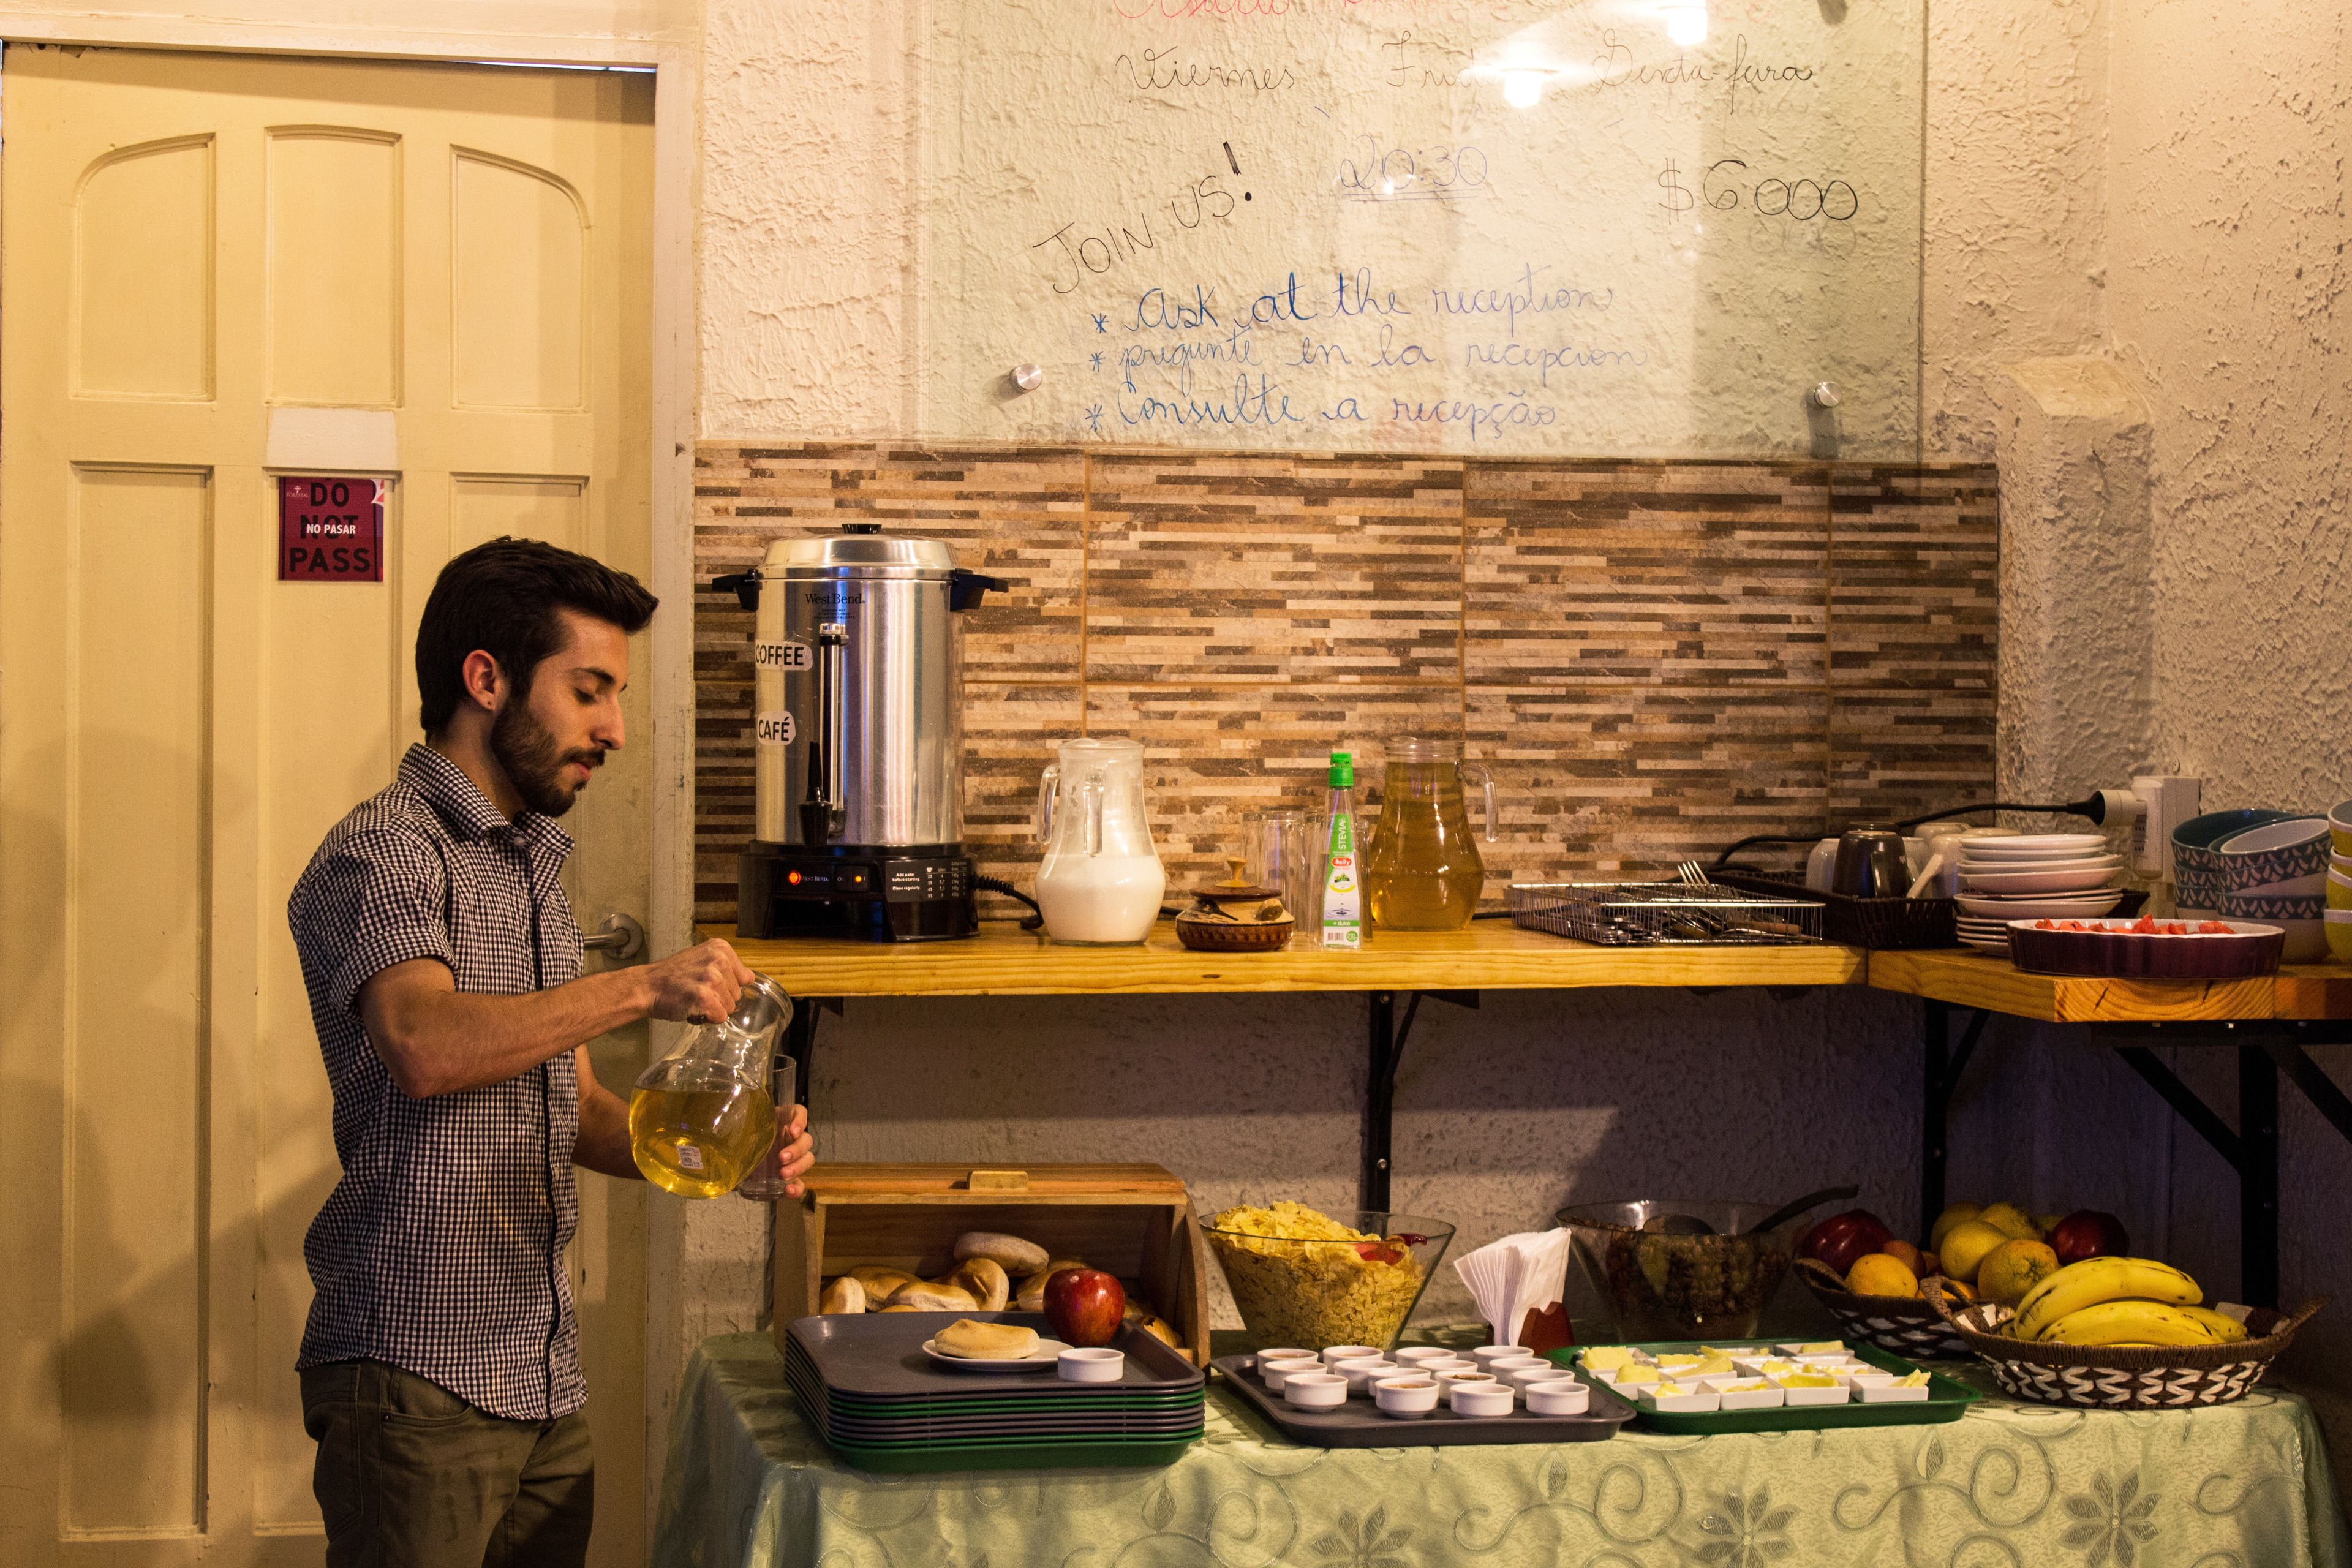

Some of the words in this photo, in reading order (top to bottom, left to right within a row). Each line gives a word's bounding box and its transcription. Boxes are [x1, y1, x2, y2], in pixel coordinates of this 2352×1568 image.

[1115, 45, 1295, 90] Viernes
[1381, 30, 1528, 105] Frid
[1340, 134, 1487, 190] 20:30
[1032, 212, 1154, 293] JOIN
[1171, 141, 1253, 228] US!
[1234, 271, 1318, 328] at
[1328, 266, 1412, 317] the
[1432, 262, 1613, 338] reception
[1286, 337, 1352, 366] en
[1371, 323, 1436, 368] la
[1322, 397, 1370, 421] a
[1392, 389, 1556, 442] recepção
[311, 482, 350, 507] DO
[300, 514, 359, 539] NOT
[307, 524, 321, 533] NO
[324, 524, 356, 534] PASAR
[290, 547, 371, 573] PASS
[805, 593, 831, 604] West
[832, 593, 862, 604] Bend
[756, 644, 804, 666] COFFEE
[759, 716, 790, 741] CAFÉ
